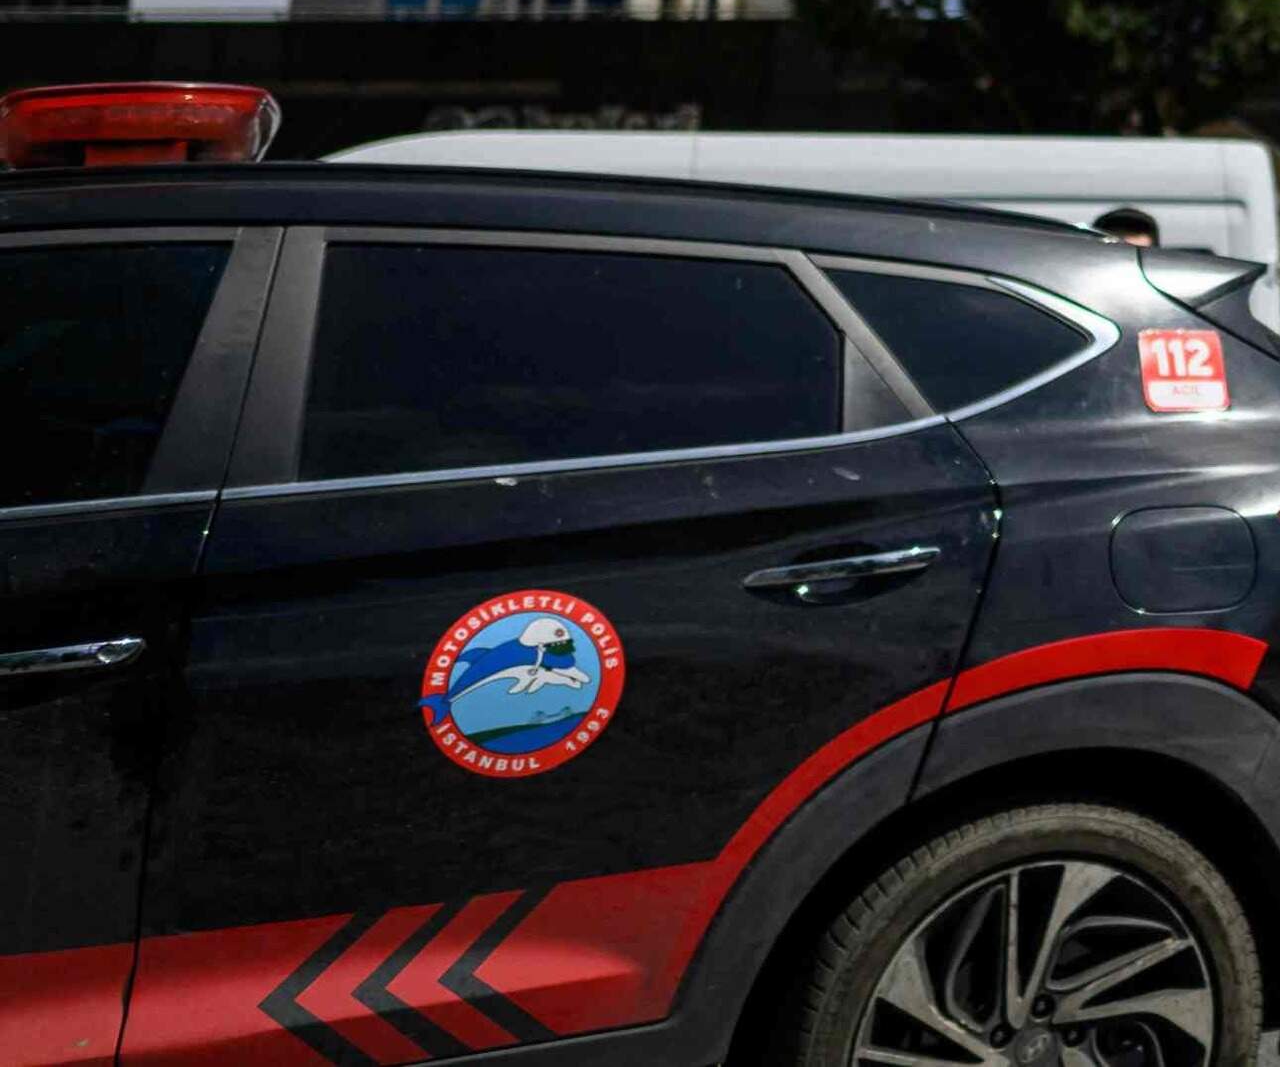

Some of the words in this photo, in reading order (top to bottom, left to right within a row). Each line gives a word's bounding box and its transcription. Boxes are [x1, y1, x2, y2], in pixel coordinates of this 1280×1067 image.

[1153, 338, 1214, 377] 112
[431, 596, 575, 686] MOTOSİKLETLİ
[580, 612, 619, 669] POLİS
[565, 708, 610, 752] 1993
